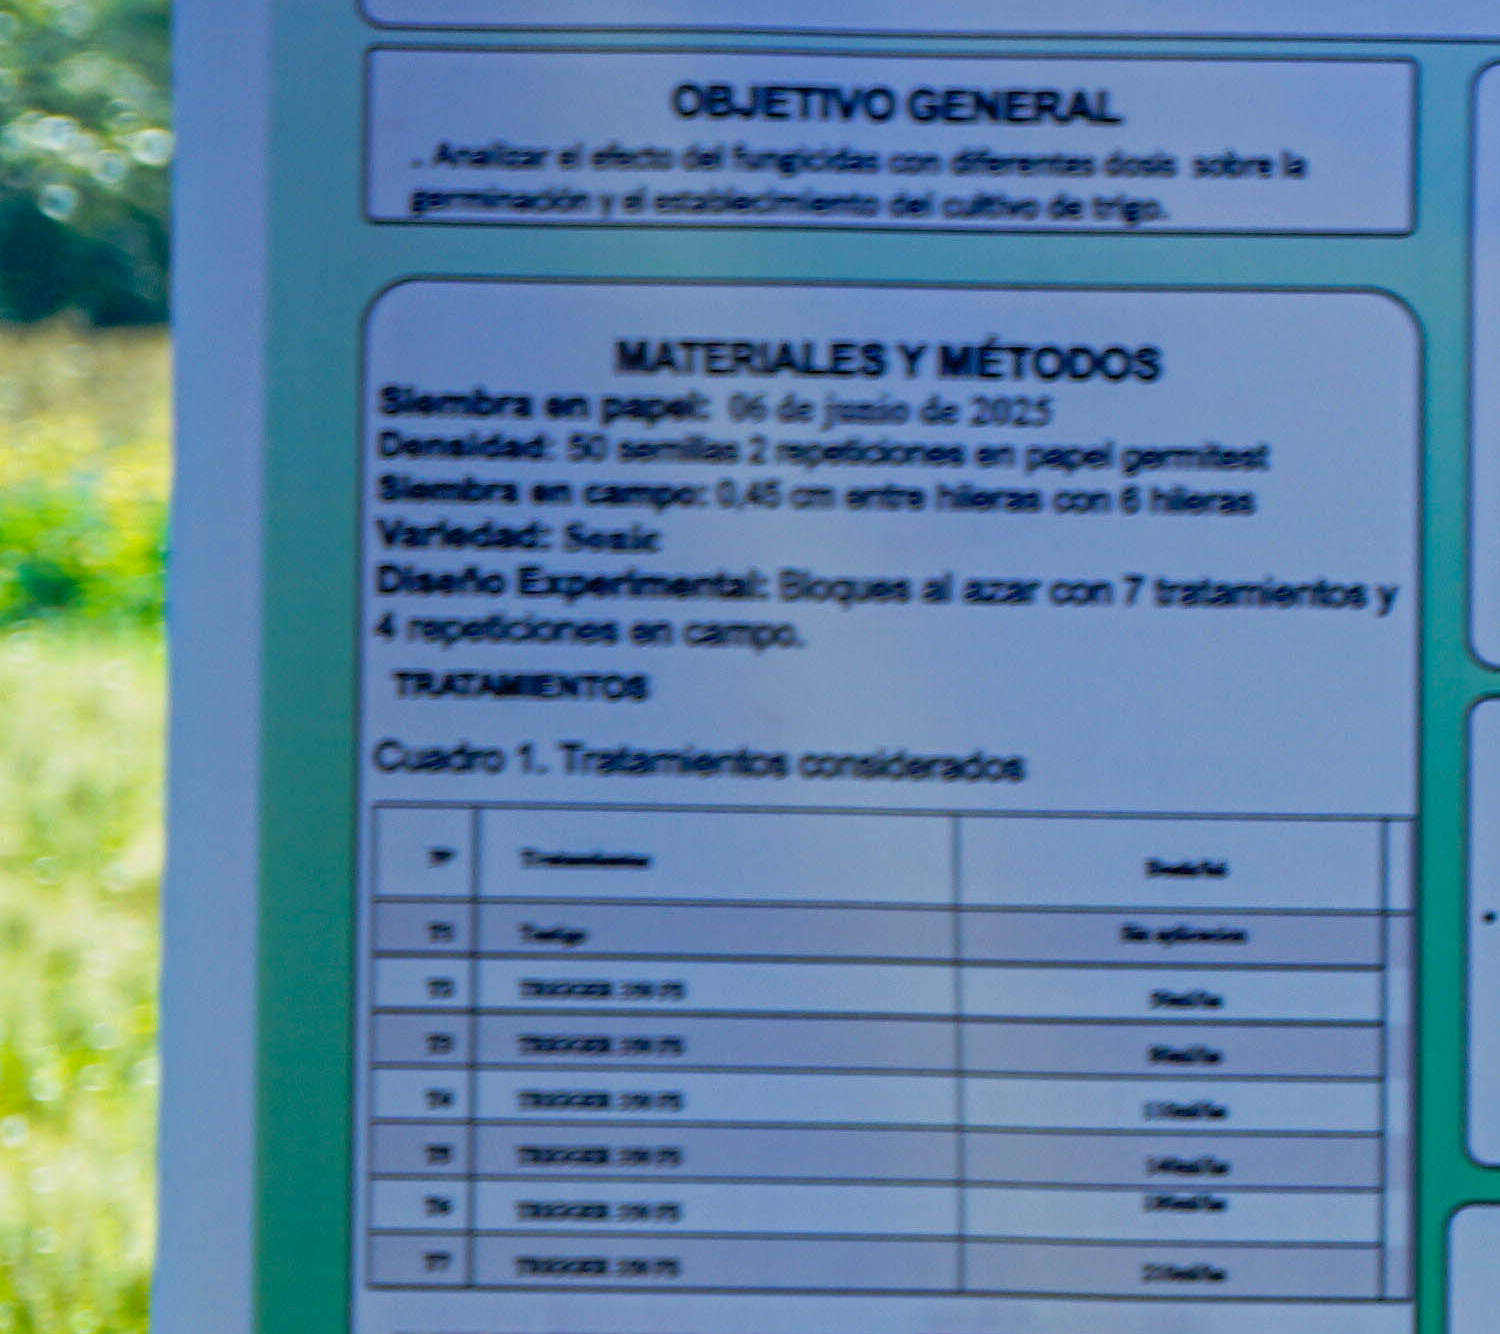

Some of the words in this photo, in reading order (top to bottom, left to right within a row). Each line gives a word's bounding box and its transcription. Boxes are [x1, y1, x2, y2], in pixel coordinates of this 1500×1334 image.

[671, 82, 897, 124] OBJETIVO
[907, 87, 1124, 127] GENERAL
[615, 339, 888, 379] MATERIALES
[897, 342, 928, 379] Y
[938, 336, 1162, 384] MÉTODOS
[392, 669, 651, 703] TRATAMIENTOS
[373, 738, 506, 775] Cuadro
[518, 743, 546, 774] 1.
[559, 740, 791, 779] Tratamientos
[798, 750, 1026, 783] considerados
